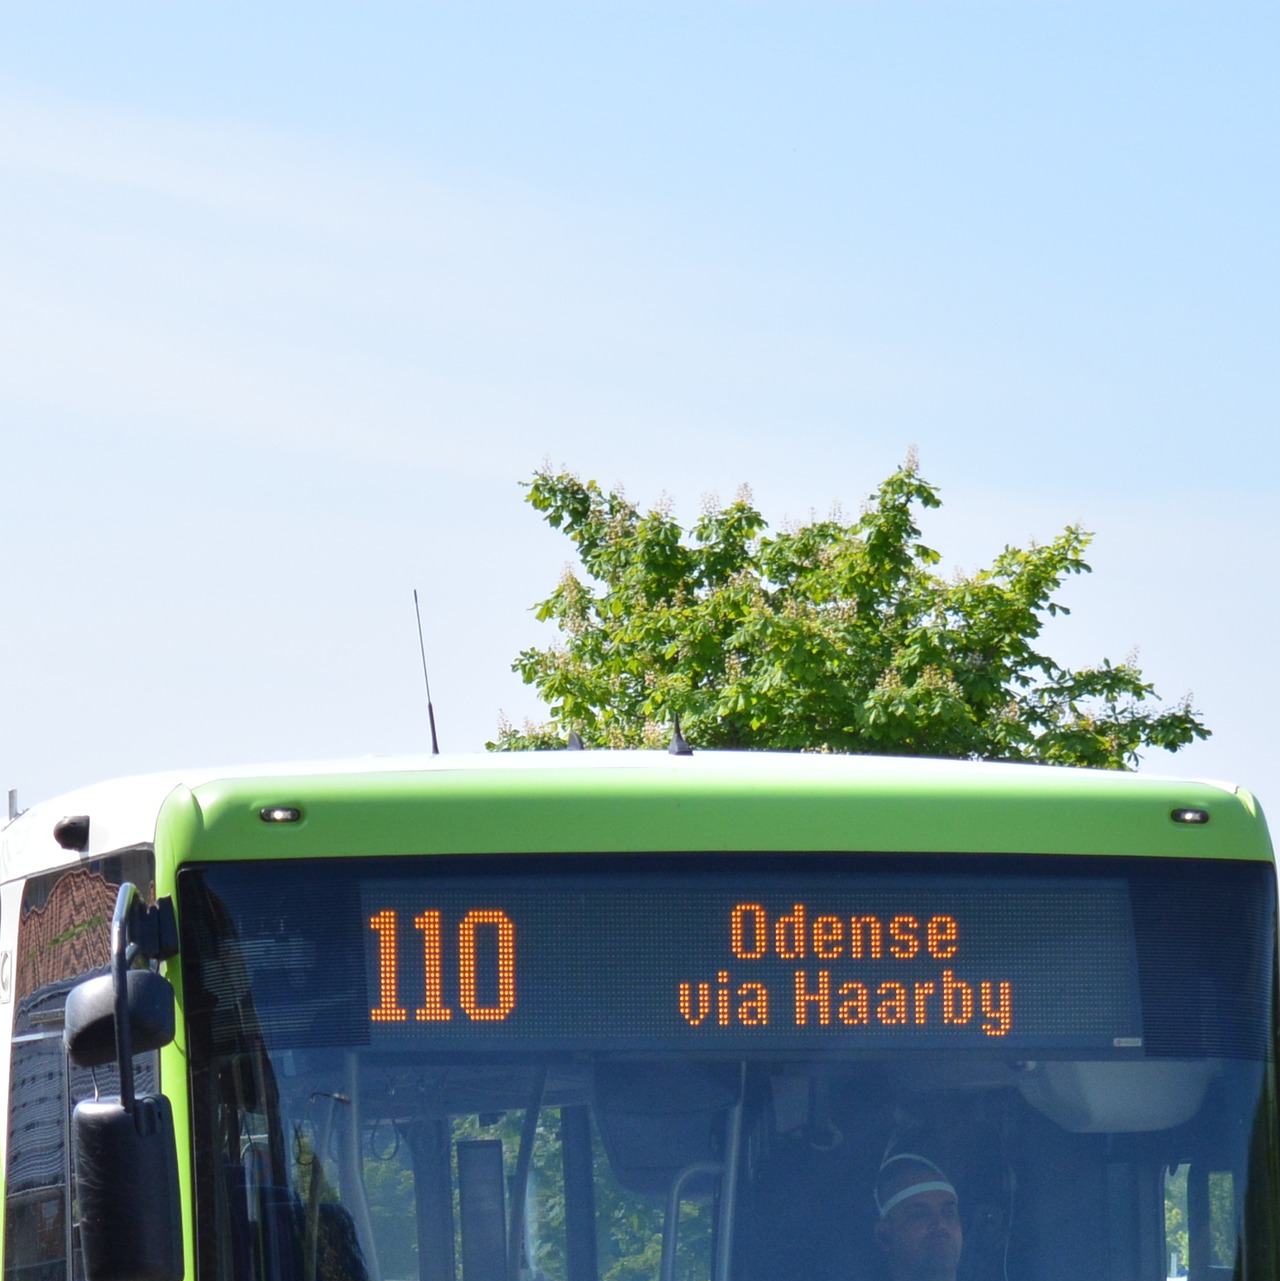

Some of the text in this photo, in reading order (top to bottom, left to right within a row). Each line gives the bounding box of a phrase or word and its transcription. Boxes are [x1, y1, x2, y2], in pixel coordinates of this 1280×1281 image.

[369, 908, 516, 1022] 110
[730, 903, 959, 960] Odense
[678, 969, 1012, 1037] via Haarby
